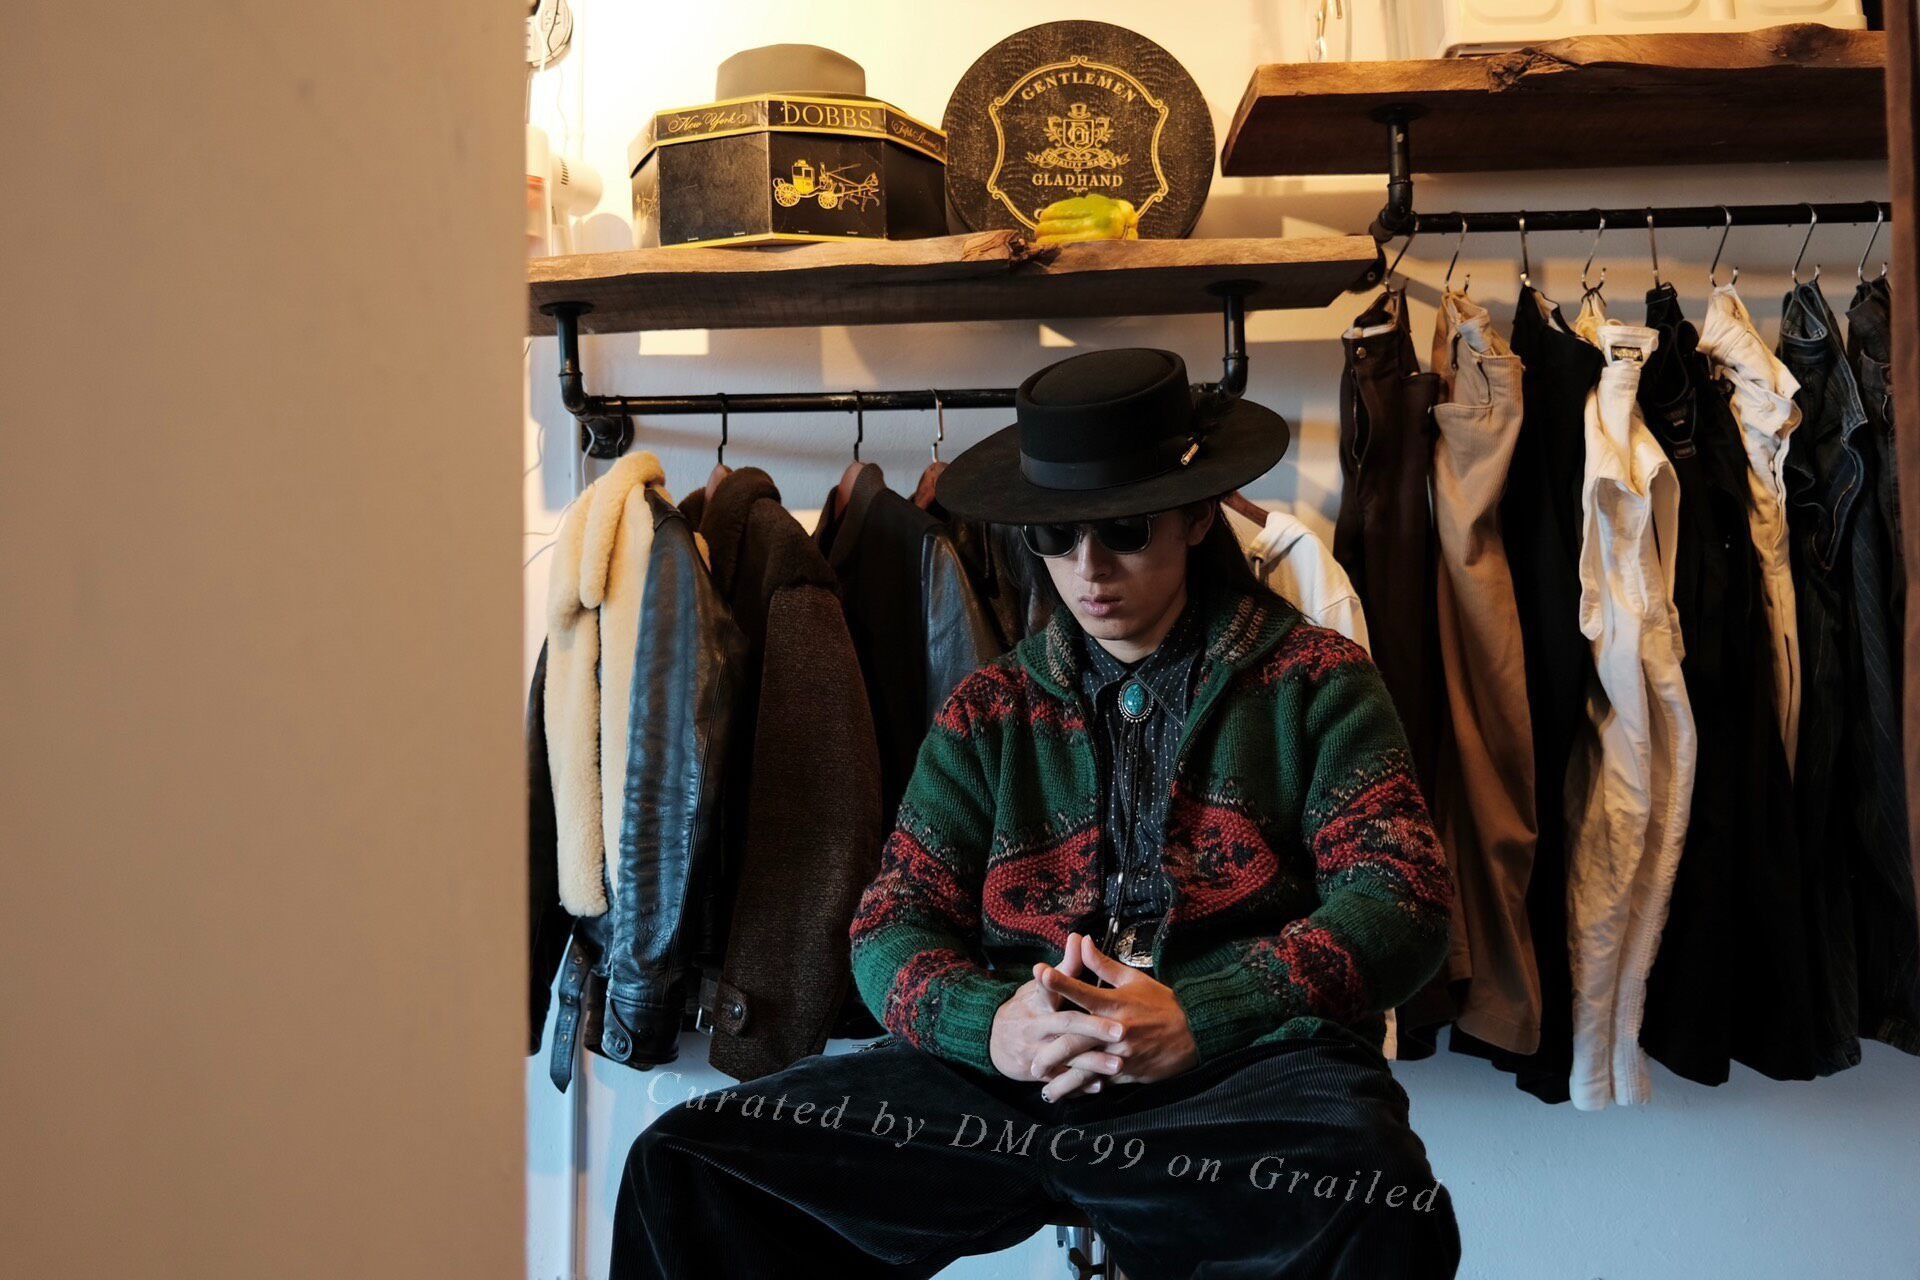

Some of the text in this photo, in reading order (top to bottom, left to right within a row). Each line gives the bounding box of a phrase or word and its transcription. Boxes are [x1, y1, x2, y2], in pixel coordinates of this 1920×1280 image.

[1021, 72, 1137, 102] GENTLEMEN
[668, 111, 747, 133] New York
[783, 104, 872, 129] DOBBS
[1032, 173, 1123, 187] GLADHAND
